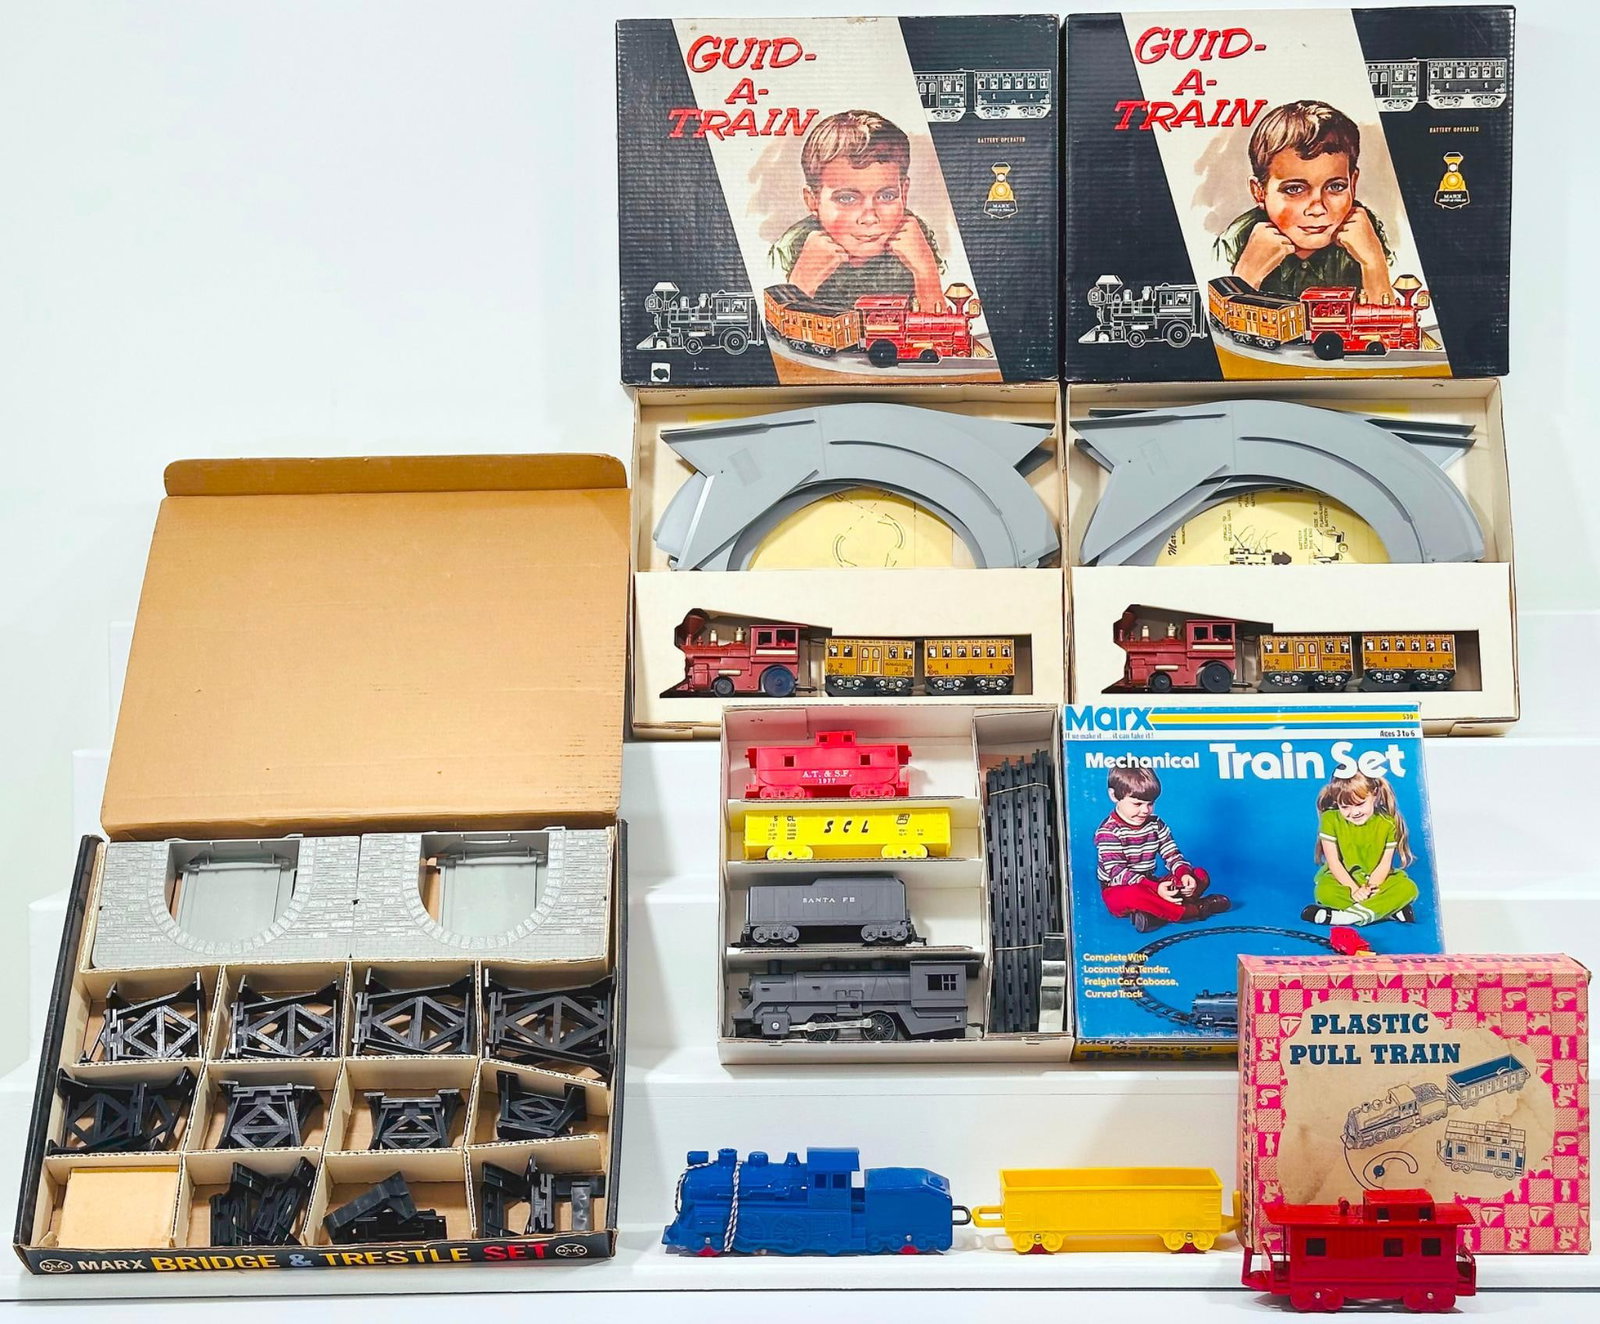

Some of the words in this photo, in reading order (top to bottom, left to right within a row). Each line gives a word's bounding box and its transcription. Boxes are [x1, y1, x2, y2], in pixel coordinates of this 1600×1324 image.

[687, 34, 817, 73] GUID-
[1135, 27, 1267, 65] GUID-
[725, 78, 769, 104] A-
[1172, 69, 1217, 95] A-
[668, 107, 819, 141] TRAIN
[1113, 98, 1268, 132] TRAIN
[1065, 705, 1154, 731] Marx
[1085, 752, 1200, 769] Mechanical
[1209, 742, 1325, 780] Train
[1331, 742, 1406, 779] Set
[824, 770, 832, 778] &
[1083, 952, 1127, 963] Complete
[1127, 952, 1149, 961] With
[1083, 965, 1138, 974] Locomotive,
[1263, 957, 1379, 967] PLASTIC
[1084, 977, 1116, 988] Freight
[1117, 977, 1136, 987] Car,
[1136, 977, 1179, 987] Caboose,
[1085, 989, 1118, 998] Curved
[1119, 989, 1144, 998] Track
[1311, 1013, 1429, 1035] PLASTIC
[1290, 1044, 1362, 1065] PULL
[1370, 1043, 1461, 1065] TRAIN
[77, 1258, 147, 1271] MARX
[150, 1254, 281, 1272] BRIDGE
[288, 1253, 314, 1268] &
[318, 1247, 472, 1266] TRESTLE
[483, 1243, 550, 1260] SET
